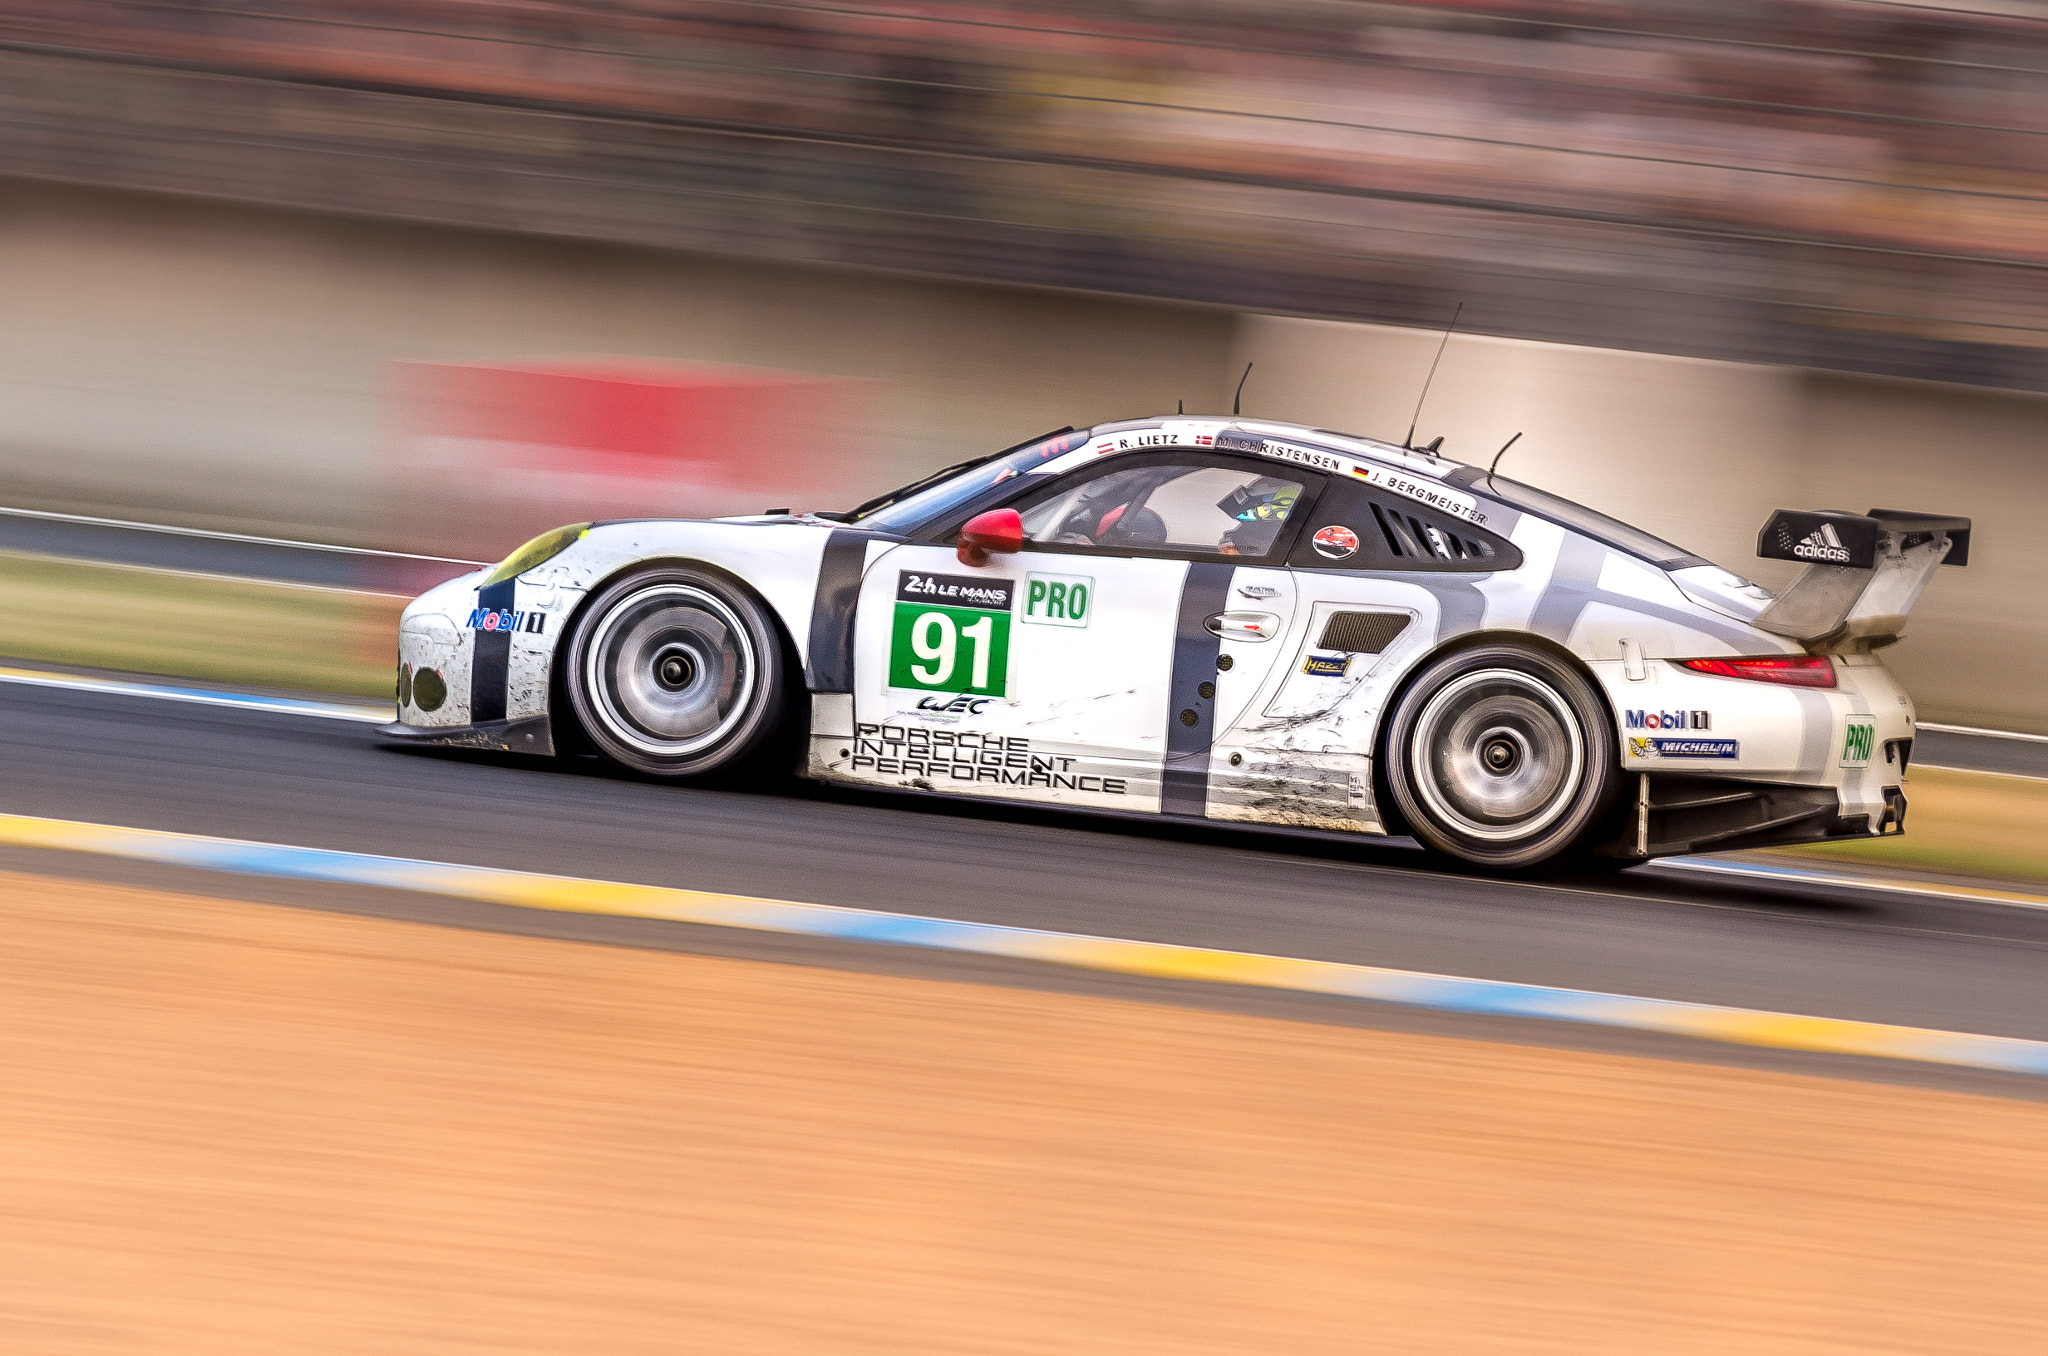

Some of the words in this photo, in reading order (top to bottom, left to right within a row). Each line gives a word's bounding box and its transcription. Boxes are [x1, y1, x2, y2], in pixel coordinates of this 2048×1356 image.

[1119, 438, 1134, 449] R.
[1138, 434, 1179, 446] LIETZ
[1239, 441, 1340, 470] CHRISTENSEN
[1371, 472, 1382, 483] J.
[1387, 477, 1490, 525] BERGMEISTER
[1793, 544, 1851, 562] adidas
[938, 584, 959, 597] LE
[959, 586, 1008, 602] MANS
[1027, 579, 1087, 620] PRO
[466, 607, 525, 632] Mobil
[911, 611, 993, 689] 91
[916, 696, 990, 715] WEC
[1625, 709, 1686, 729] Mobil
[857, 722, 1029, 752] PORSCHE
[1660, 742, 1735, 752] MICHELIN
[1843, 724, 1873, 761] PRO
[854, 740, 1076, 772] INTELLIGENT
[851, 755, 1125, 794] PERFORMANCE
